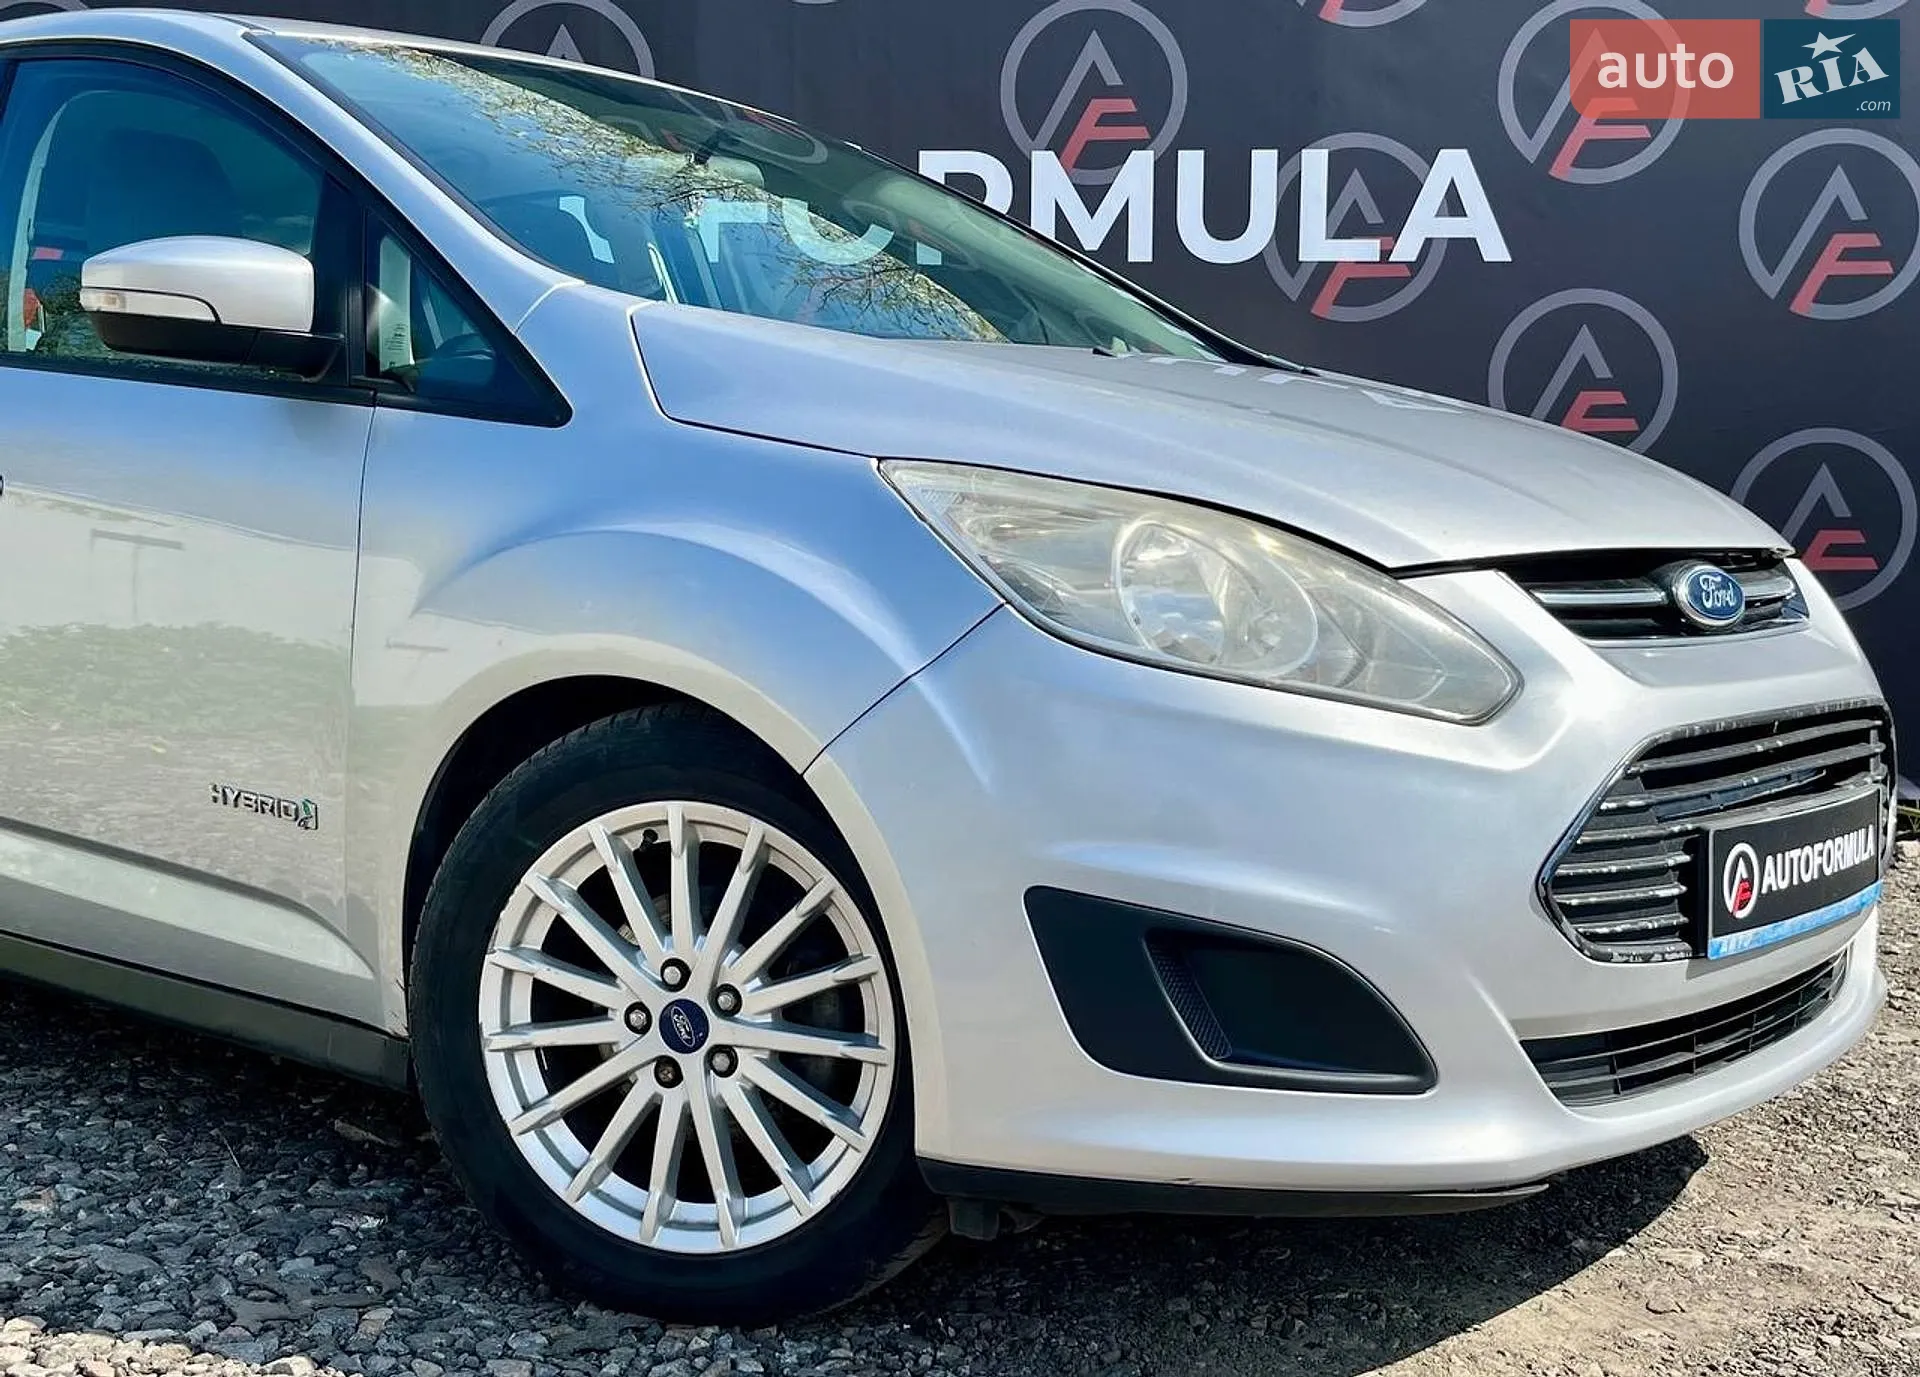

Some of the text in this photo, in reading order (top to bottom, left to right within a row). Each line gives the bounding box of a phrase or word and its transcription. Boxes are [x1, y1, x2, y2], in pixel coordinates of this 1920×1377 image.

[1699, 574, 1737, 609] Ford
[208, 783, 300, 822] HYBRID
[1761, 824, 1875, 895] AUTOFORMULA
